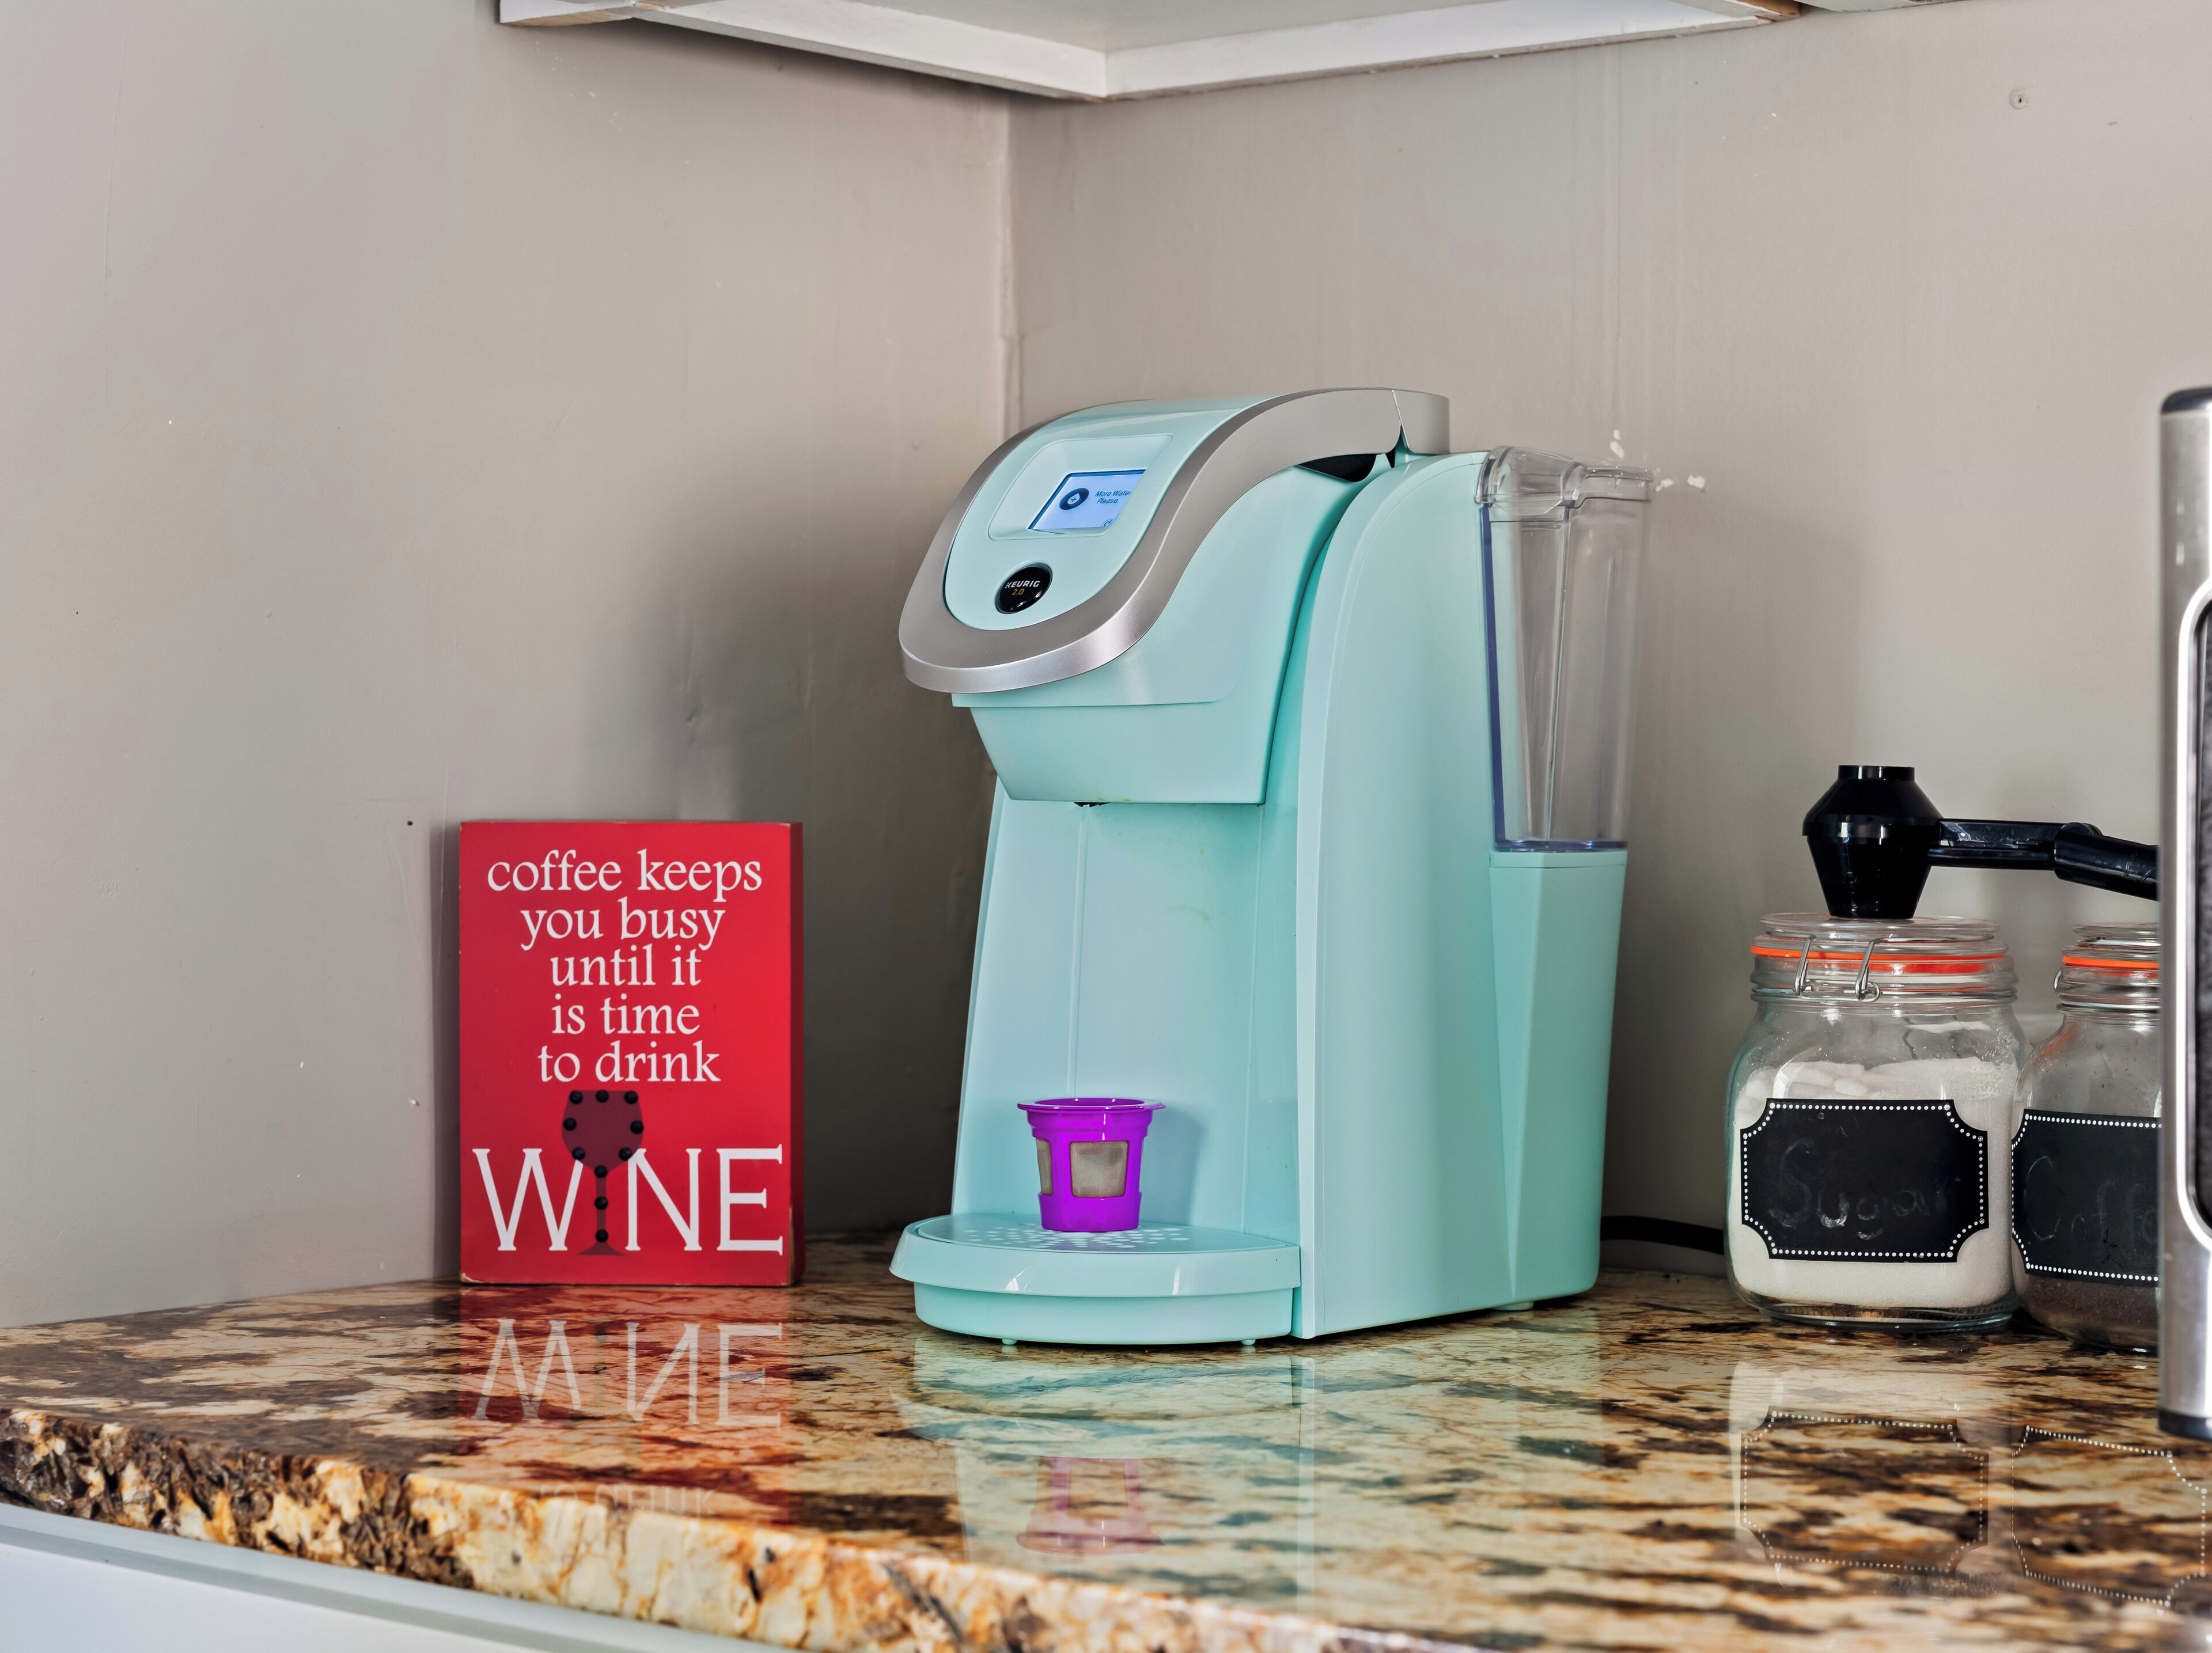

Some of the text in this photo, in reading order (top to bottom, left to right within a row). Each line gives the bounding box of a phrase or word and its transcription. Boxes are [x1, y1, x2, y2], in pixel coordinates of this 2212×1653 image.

[1005, 581, 1041, 589] KEURIG
[487, 848, 762, 903] coffee keeps
[520, 896, 726, 951] you busy
[550, 943, 702, 986] until it
[552, 993, 700, 1035] is time
[537, 1040, 721, 1082] to drink
